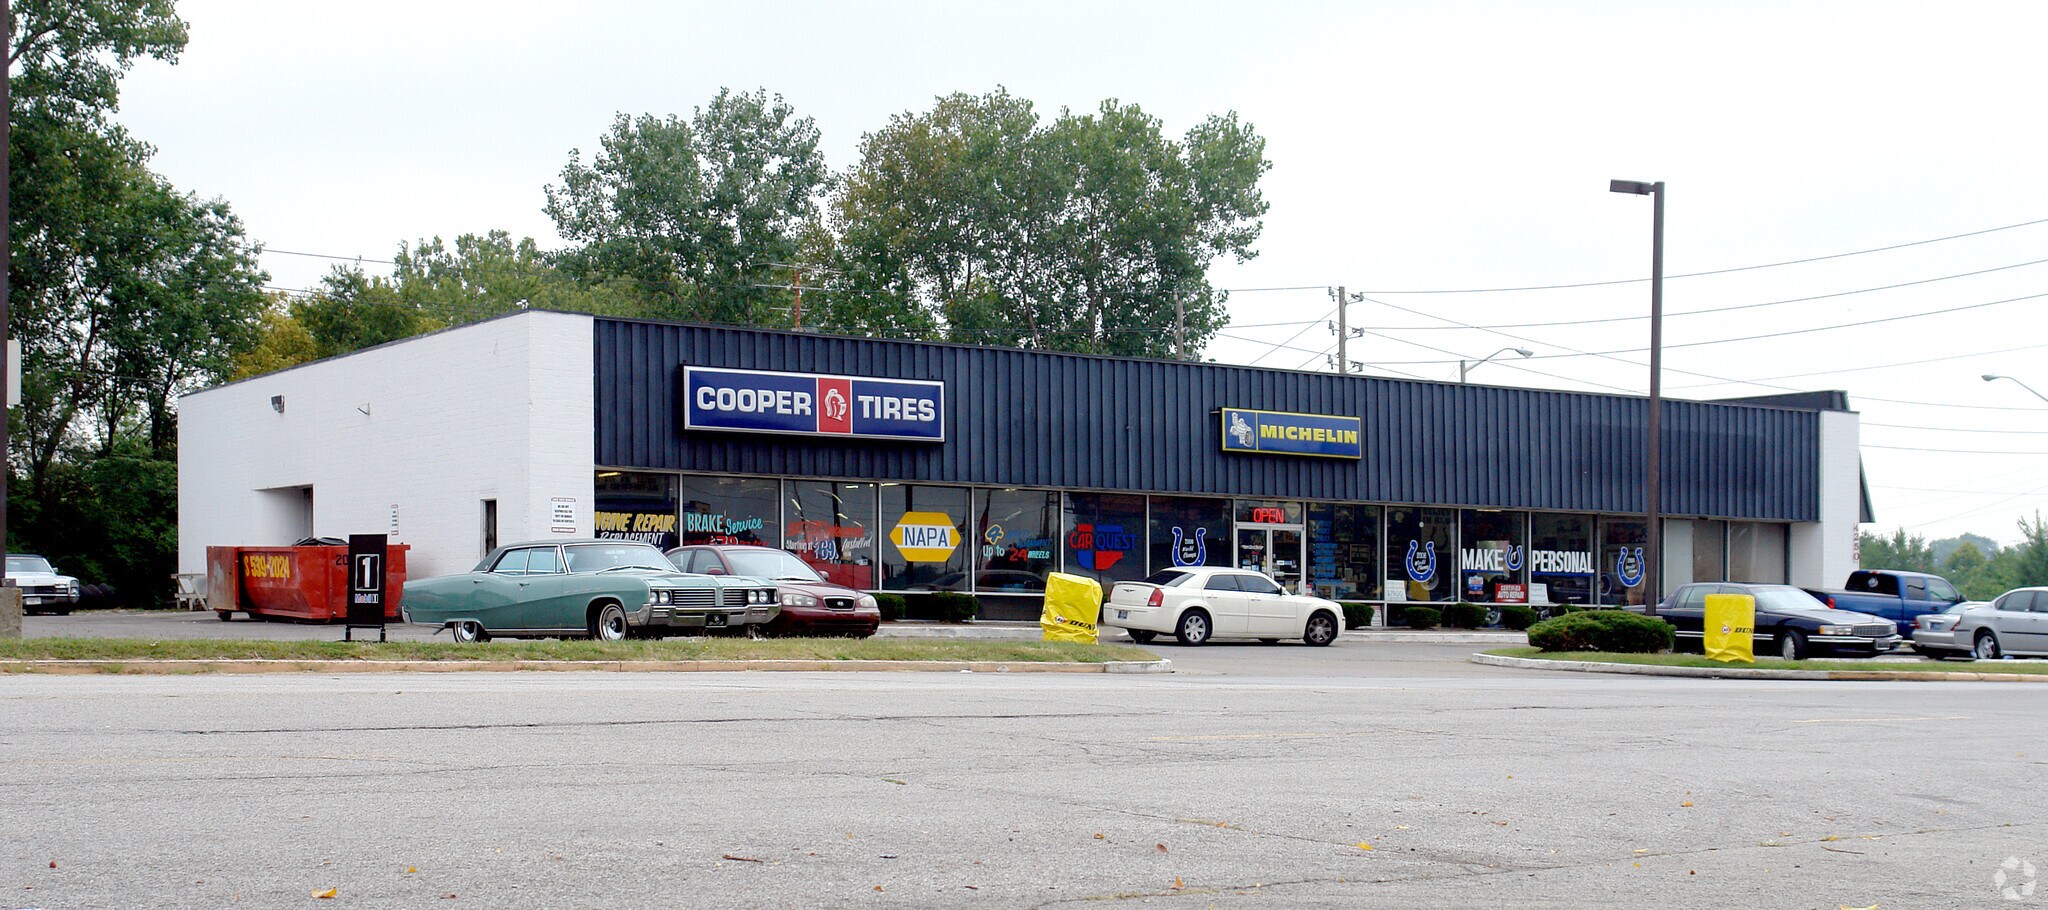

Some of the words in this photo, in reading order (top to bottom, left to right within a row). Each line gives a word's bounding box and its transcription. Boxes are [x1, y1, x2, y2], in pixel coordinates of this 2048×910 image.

[696, 386, 812, 416] COOPER
[857, 395, 936, 422] TIRES
[1260, 425, 1358, 444] MICHELIN
[633, 513, 676, 533] REPAIR
[687, 513, 724, 533] BRAKE
[725, 514, 763, 535] Service
[1253, 508, 1285, 524] OPEN
[841, 532, 873, 552] Installed
[903, 527, 948, 547] NAPA
[985, 524, 1004, 545] 4
[995, 545, 1005, 557] to
[1009, 548, 1028, 562] 24
[1027, 550, 1050, 559] WHEELS
[1461, 548, 1504, 571] MAKE
[1532, 550, 1595, 574] PERSONAL
[250, 555, 290, 578] 539-2024
[362, 557, 371, 588] 1
